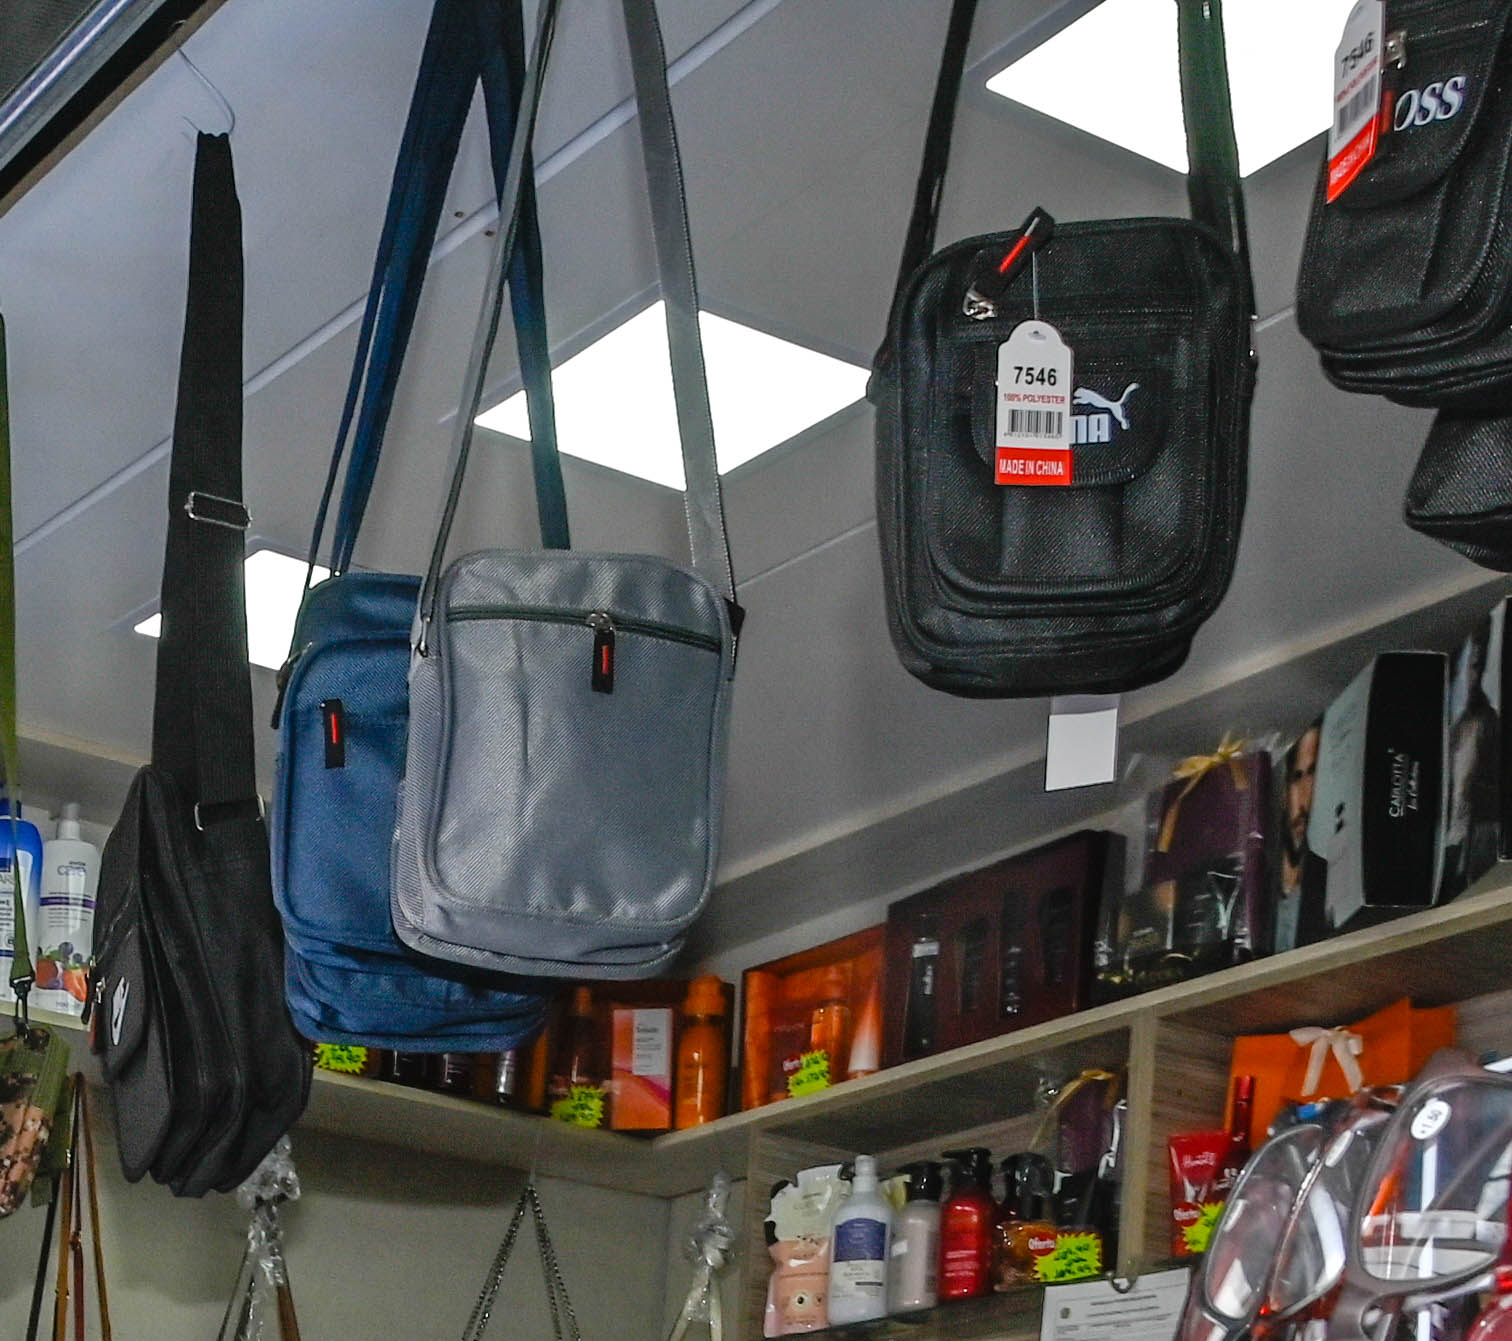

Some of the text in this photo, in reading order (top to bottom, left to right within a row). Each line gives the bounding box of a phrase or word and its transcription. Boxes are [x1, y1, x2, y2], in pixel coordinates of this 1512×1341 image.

[1014, 366, 1057, 386] 7546
[1022, 394, 1065, 404] POLYESTER
[999, 459, 1064, 476] MADE IN CHINA
